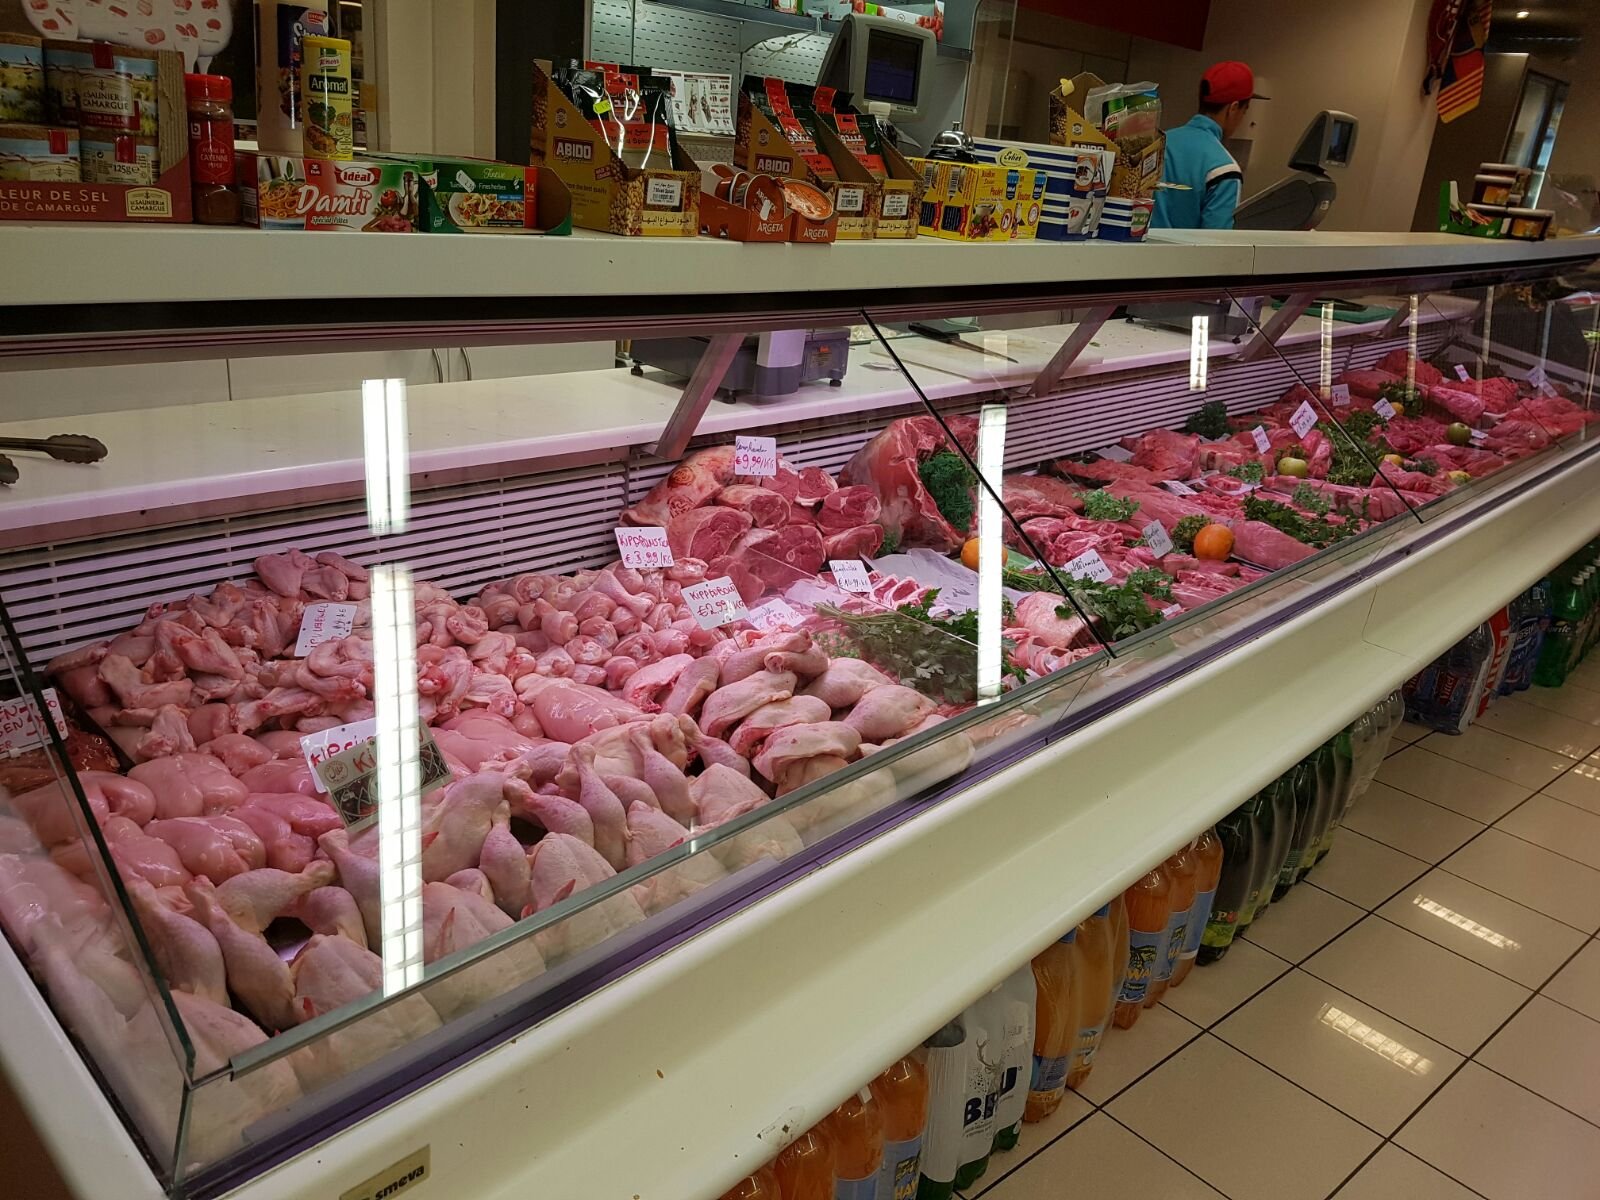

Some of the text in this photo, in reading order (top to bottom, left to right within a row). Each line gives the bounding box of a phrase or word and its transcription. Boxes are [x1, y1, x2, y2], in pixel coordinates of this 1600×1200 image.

[311, 76, 347, 93] Aromat
[82, 99, 128, 110] CAMARGUE
[556, 141, 592, 160] ABIDO
[200, 153, 228, 162] CAYENNE
[756, 158, 791, 174] ABIDO
[343, 170, 371, 182] Idéal
[526, 182, 535, 192] 14
[51, 190, 72, 201] DE
[79, 189, 110, 202] SEL
[1, 201, 97, 213] DE CAMARGUE
[757, 222, 783, 234] ARGETA
[803, 227, 828, 239] ARGETA
